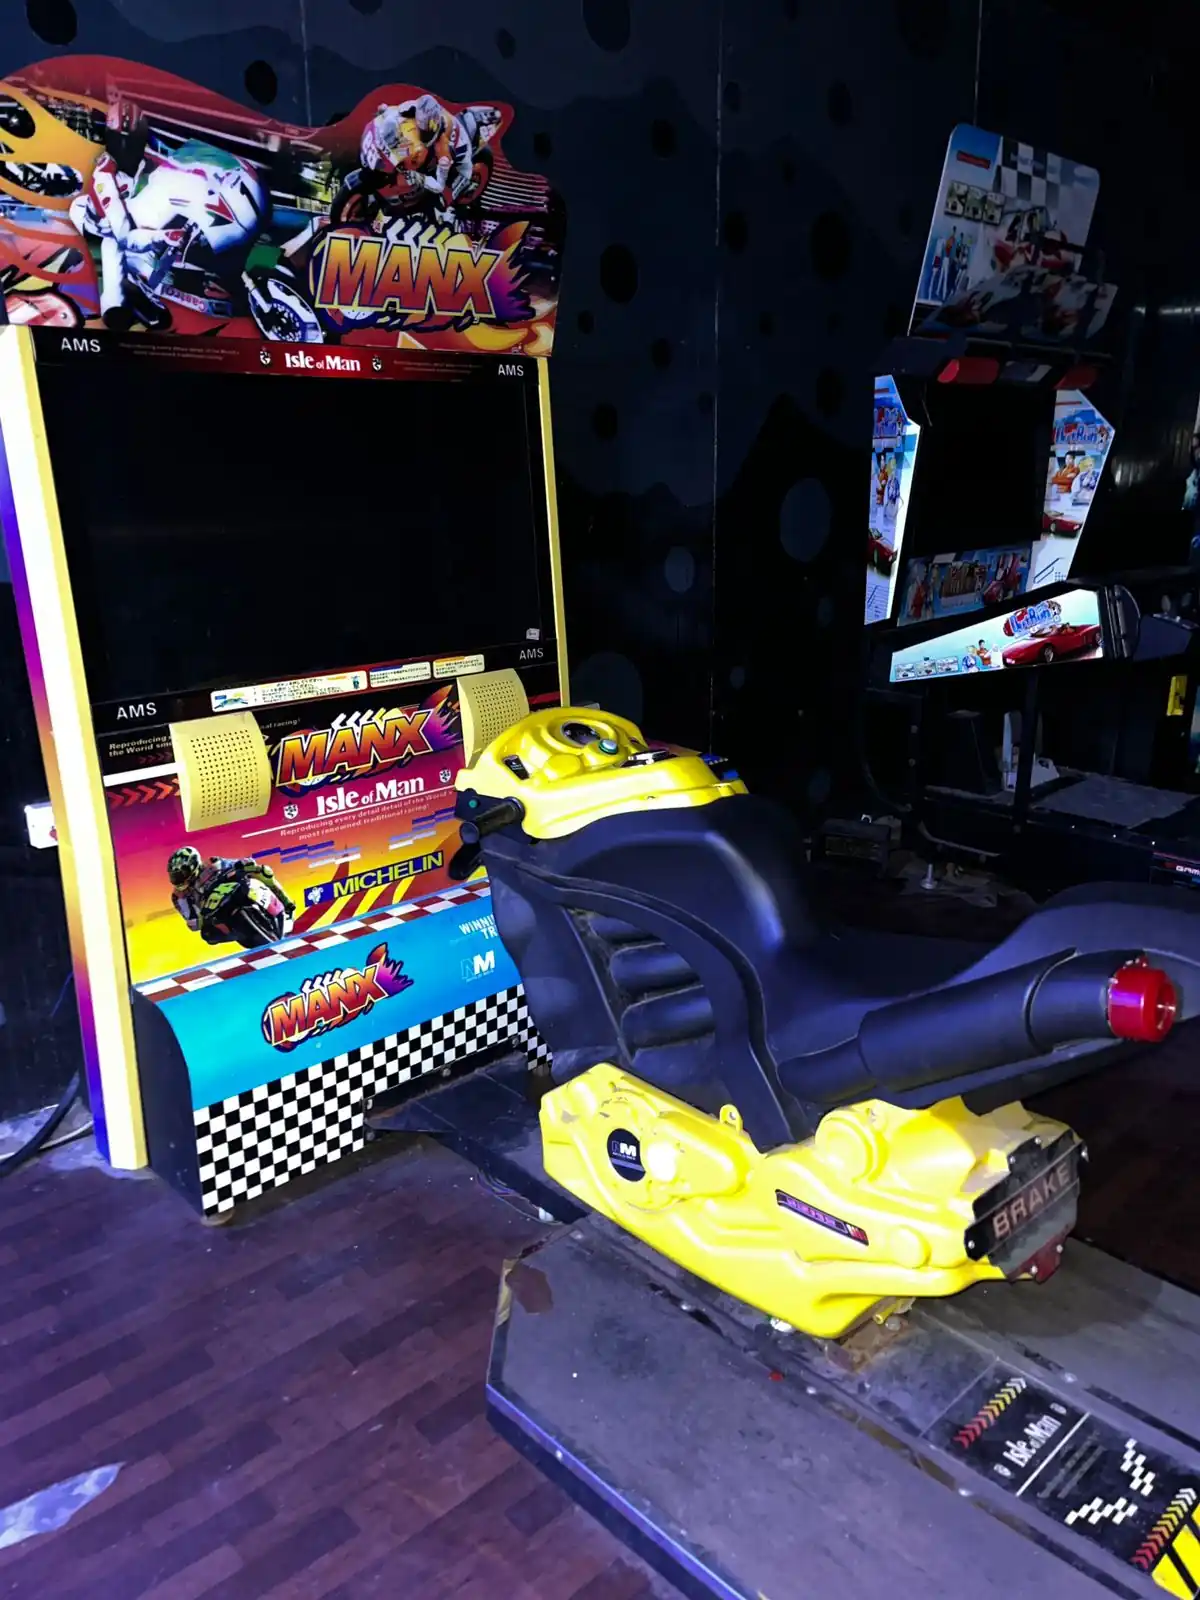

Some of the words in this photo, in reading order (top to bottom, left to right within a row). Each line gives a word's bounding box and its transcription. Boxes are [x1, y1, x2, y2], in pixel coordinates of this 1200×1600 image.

[315, 232, 503, 318] MANX
[61, 337, 101, 353] AMS
[284, 351, 315, 369] Isle
[325, 355, 361, 372] Man
[497, 363, 524, 377] AMS
[519, 648, 544, 660] AMS
[116, 702, 157, 720] AMS
[108, 736, 167, 750] Reproducing
[126, 744, 154, 754] World
[276, 709, 434, 787] MANX
[316, 786, 360, 817] Isle
[361, 790, 375, 805] of
[375, 776, 425, 803] Man
[280, 820, 334, 837] Reproducing
[334, 813, 357, 824] every
[358, 807, 380, 818] detail
[381, 801, 403, 812] detail
[299, 830, 320, 841] most
[363, 808, 404, 825] traditional
[333, 851, 443, 898] MICHELIN
[480, 925, 499, 940] TR
[268, 962, 389, 1046] MANX
[992, 1162, 1071, 1239] BRAKE
[1002, 1440, 1037, 1468] Isle
[1023, 1414, 1062, 1445] Man
